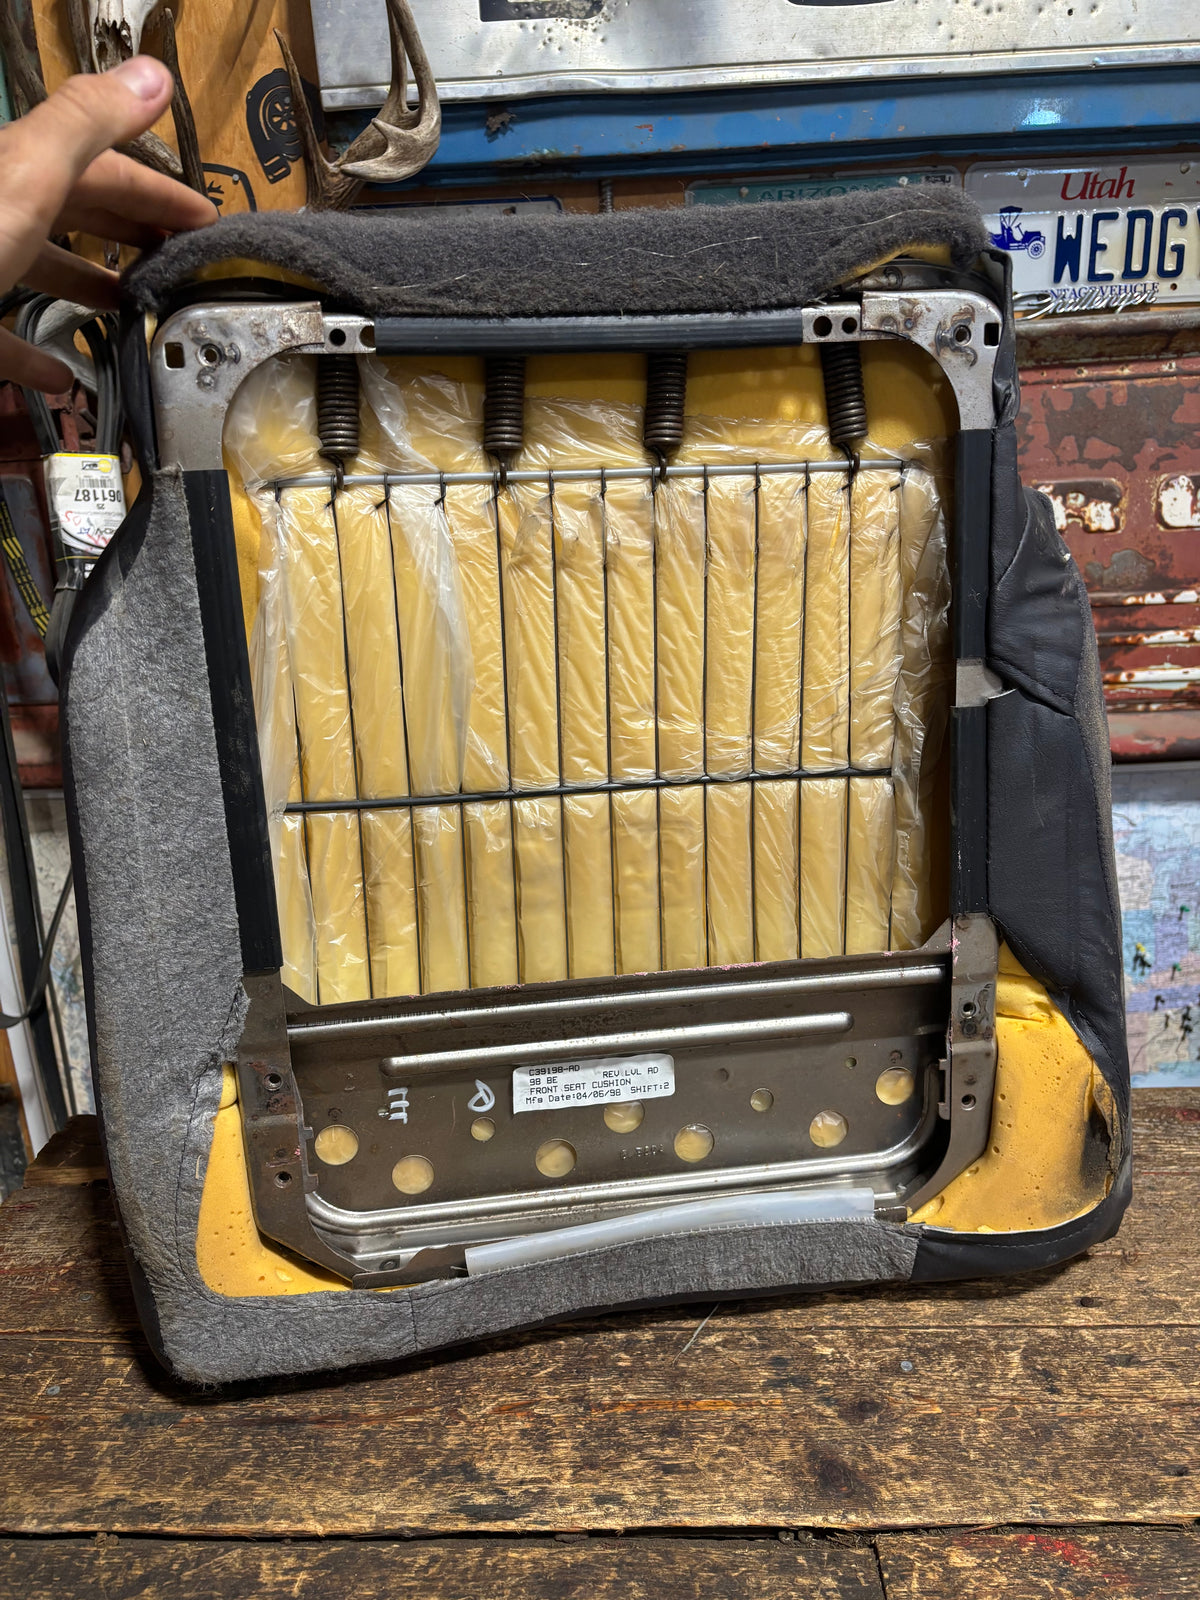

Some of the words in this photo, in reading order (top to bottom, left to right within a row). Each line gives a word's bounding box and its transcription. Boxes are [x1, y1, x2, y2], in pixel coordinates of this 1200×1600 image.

[1060, 166, 1135, 200] Utah
[759, 183, 886, 202] ARIZO
[1053, 208, 1200, 284] WEDG
[74, 488, 122, 503] 061187
[528, 1064, 580, 1076] C39198-AD
[529, 1077, 541, 1086] 98
[546, 1076, 558, 1084] BE
[602, 1069, 620, 1078] REV
[625, 1068, 642, 1076] LVL
[647, 1066, 659, 1074] AD
[529, 1085, 558, 1095] FRONT
[564, 1082, 586, 1092] SEAT
[592, 1078, 631, 1089] CUSHION
[630, 1081, 669, 1094] SHIFT:2
